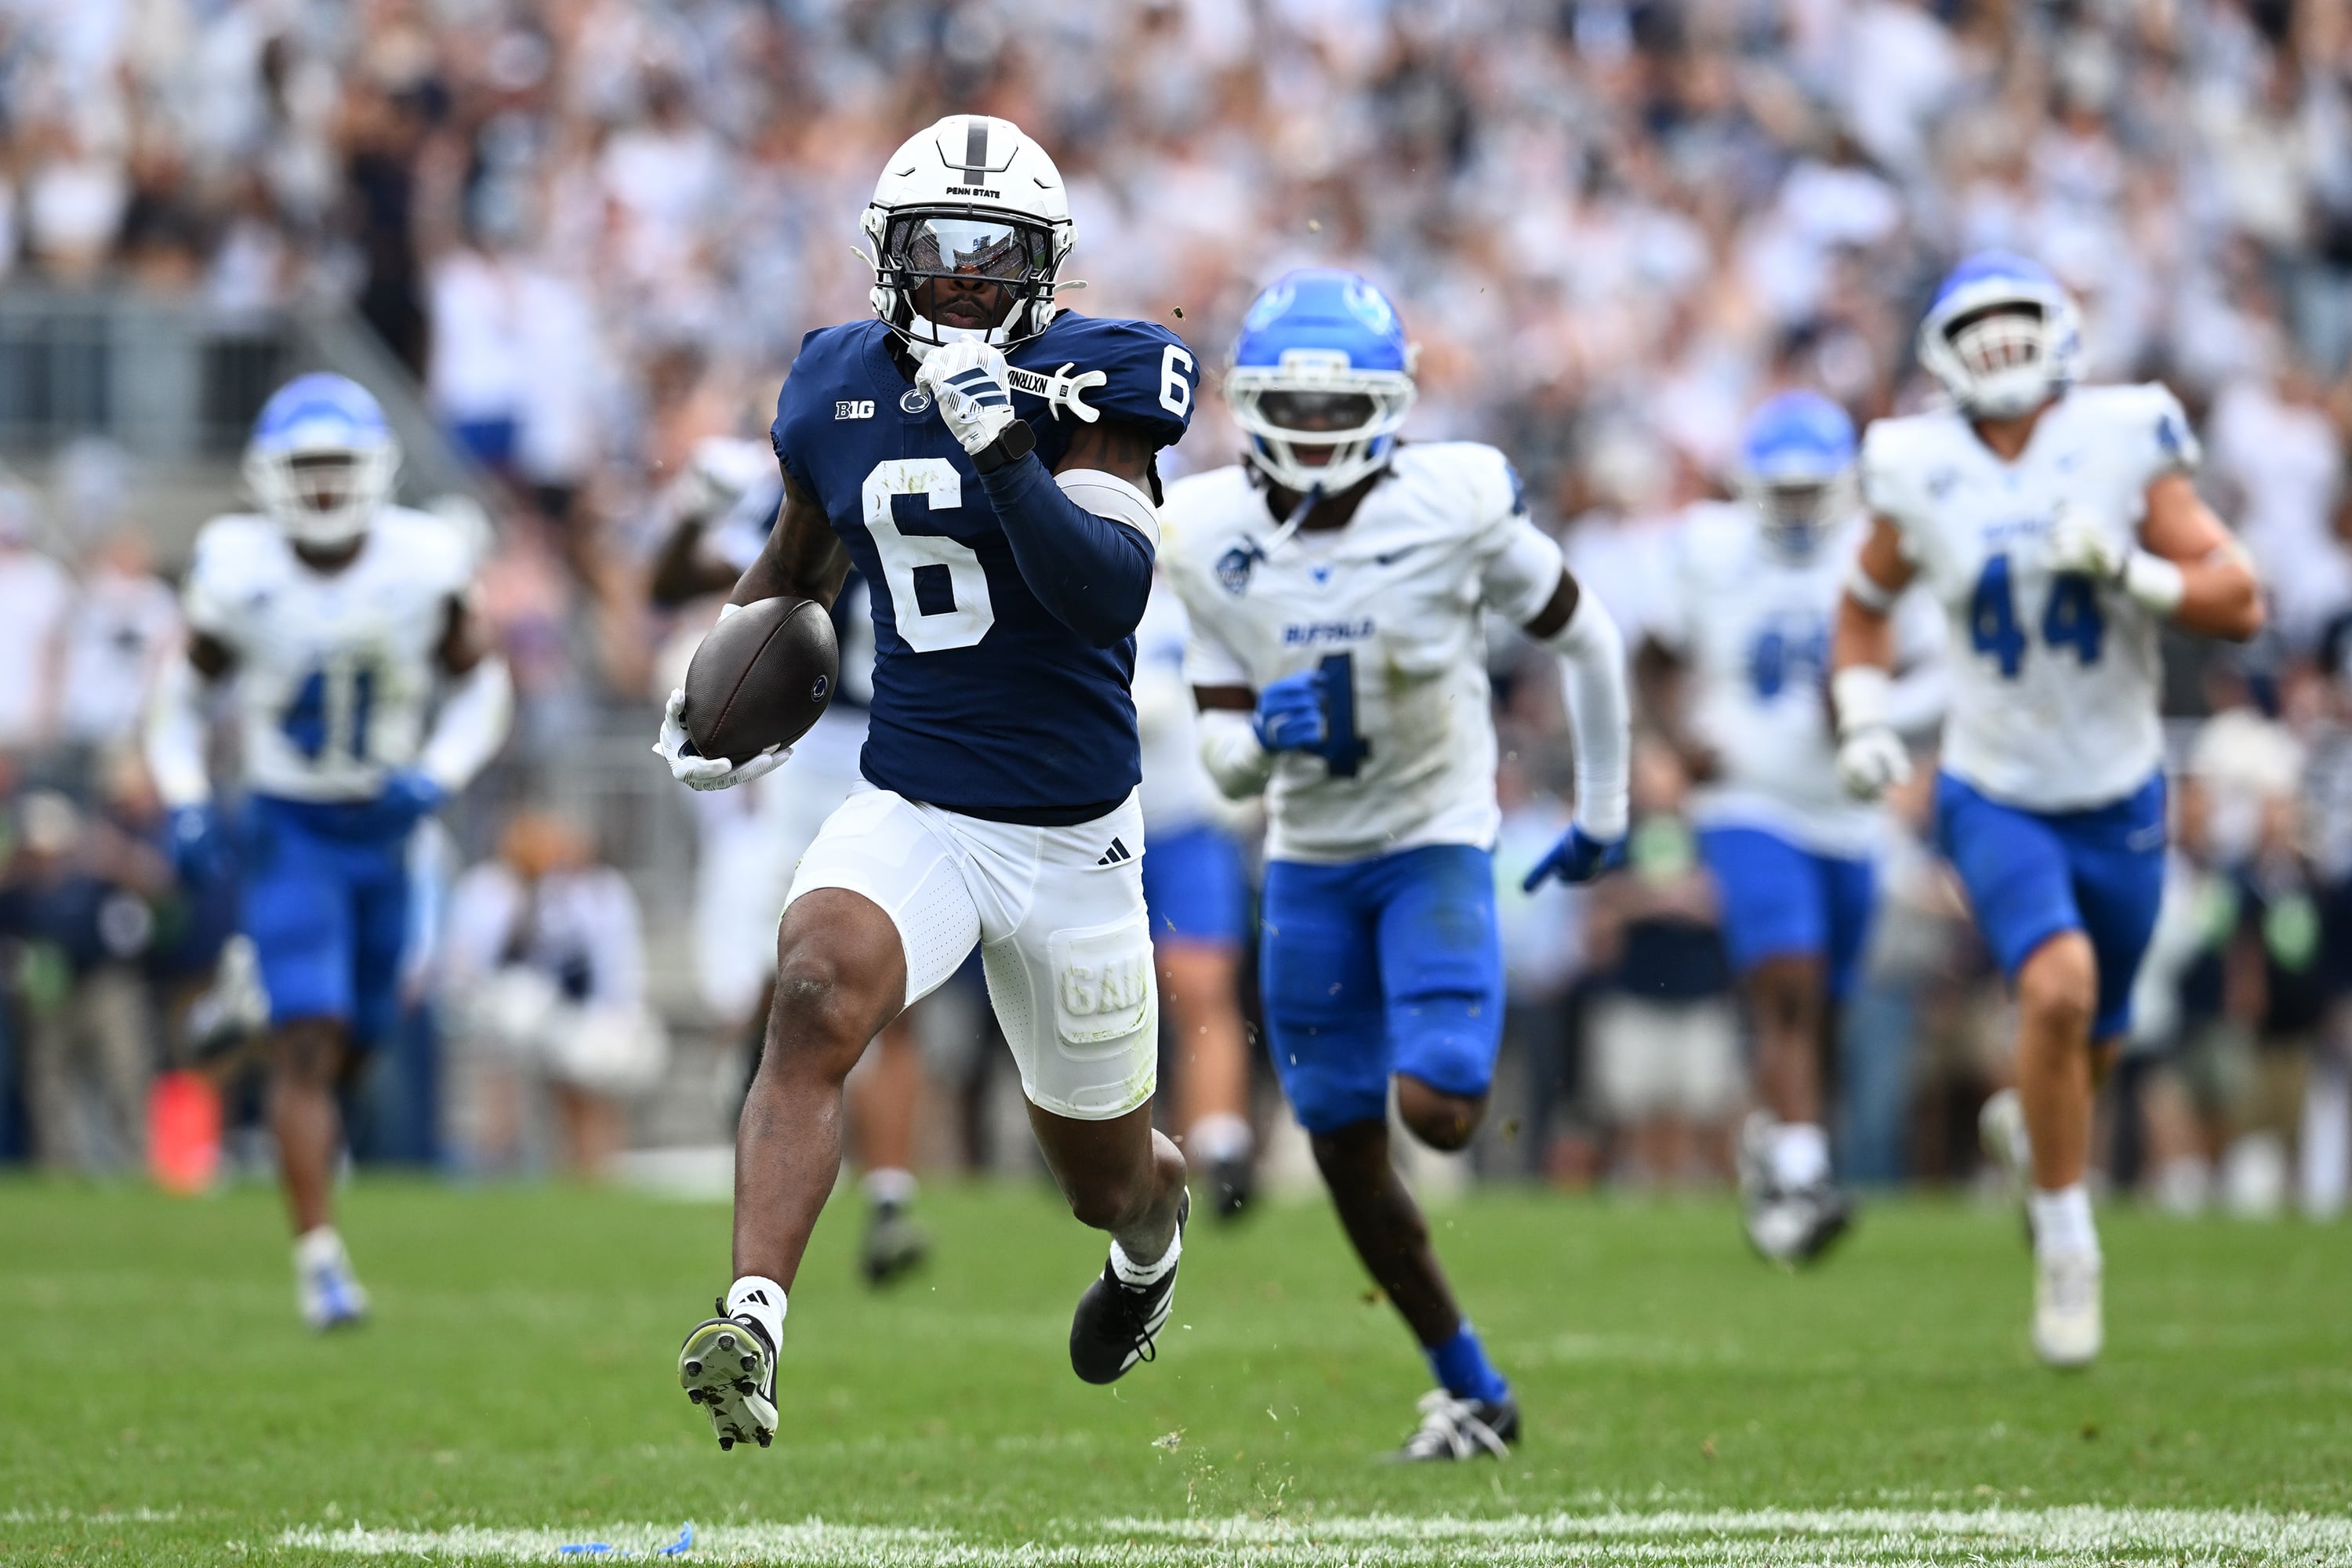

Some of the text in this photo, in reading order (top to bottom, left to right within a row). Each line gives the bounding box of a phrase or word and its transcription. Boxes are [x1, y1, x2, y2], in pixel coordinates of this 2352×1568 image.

[946, 187, 1000, 199] PENN STATE
[1160, 343, 1194, 419] 6
[862, 458, 995, 653] 6
[1969, 553, 2107, 679] 44
